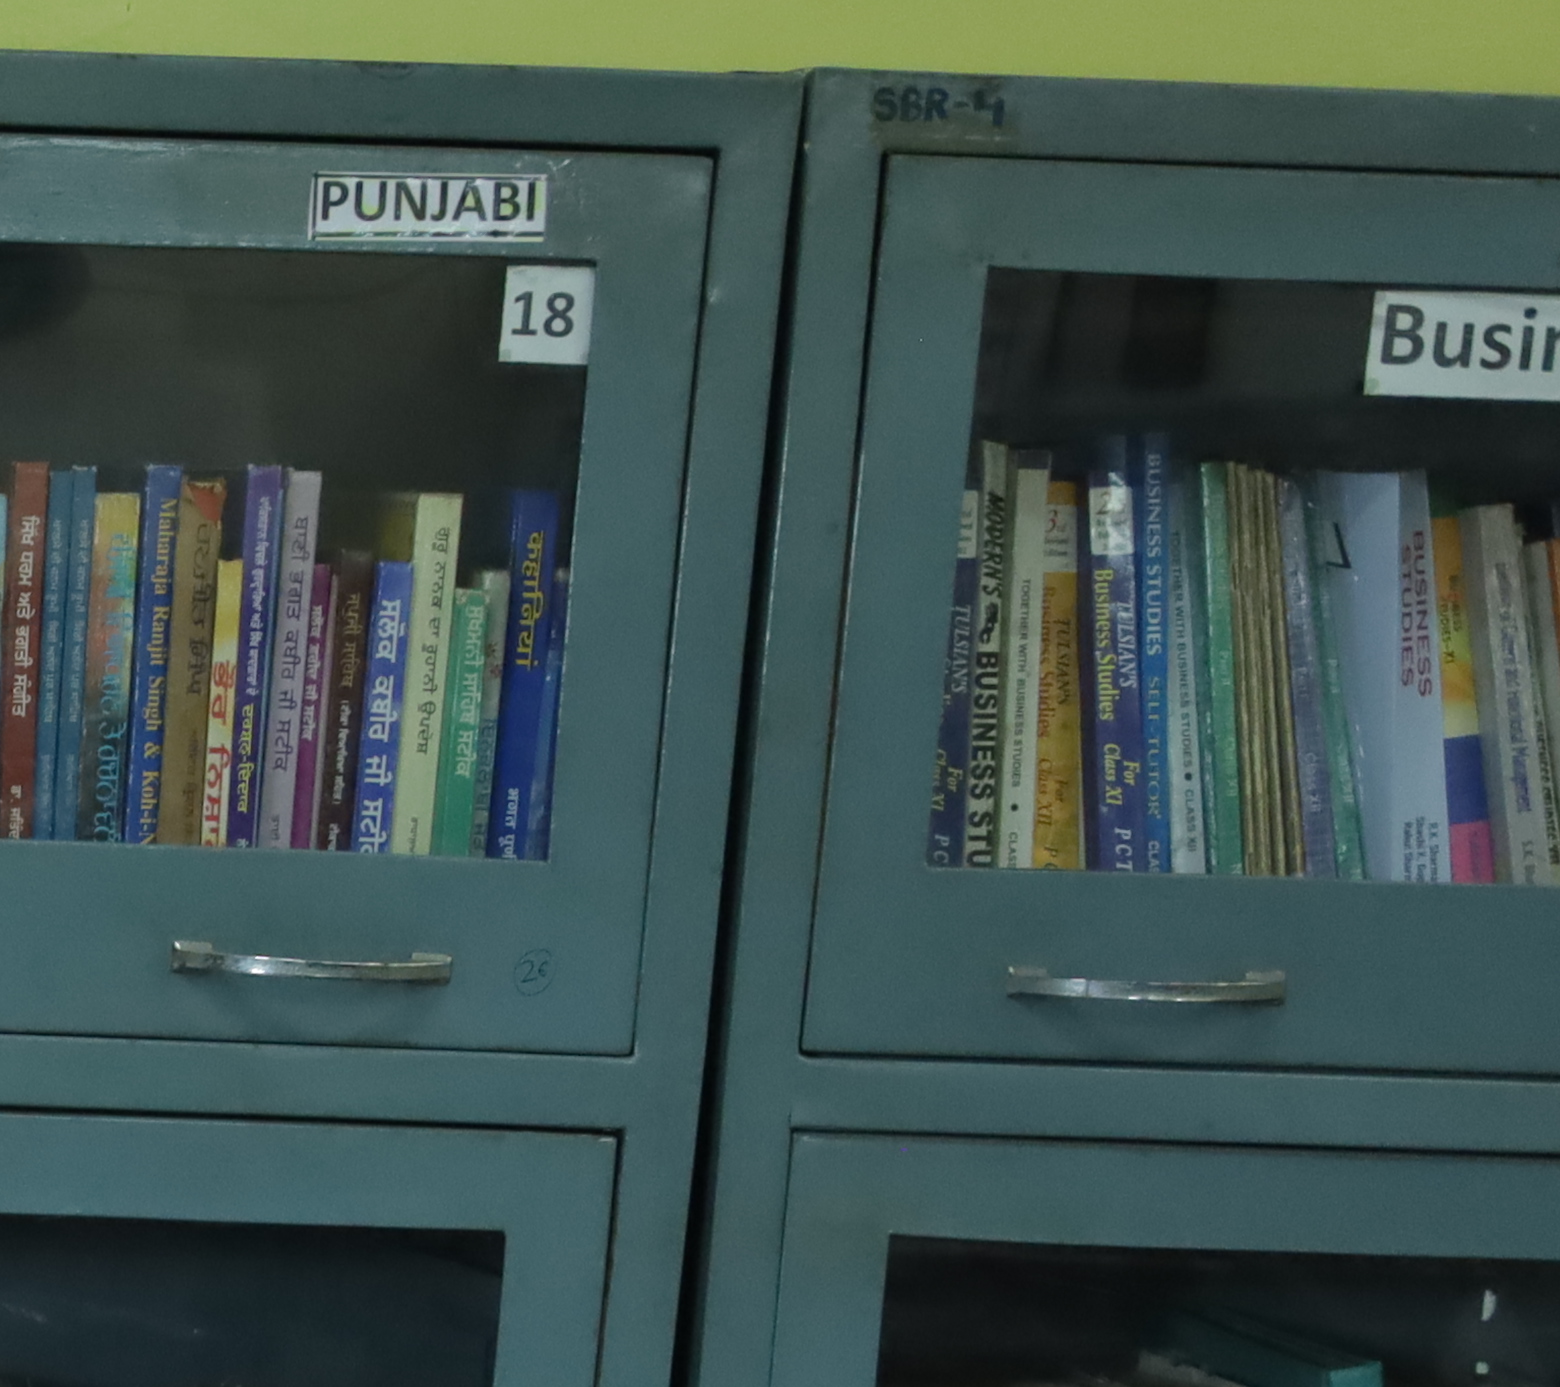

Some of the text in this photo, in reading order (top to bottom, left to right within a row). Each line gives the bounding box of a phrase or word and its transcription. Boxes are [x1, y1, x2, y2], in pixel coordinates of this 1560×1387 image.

[321, 180, 537, 222] PUNJABI
[511, 291, 576, 337] 18
[1146, 454, 1162, 557] BUSINESS
[290, 517, 311, 560] ਬਾਣੀ
[981, 492, 1003, 598] MODERN'S
[17, 551, 33, 584] ਧਰਮ
[430, 561, 449, 610] ਨਾਨਕ
[144, 499, 176, 759] Maharaja Ranjit Singh &
[429, 617, 441, 638] ਦਾ
[1146, 564, 1163, 656] STUDIES
[1400, 543, 1414, 686] STUDIES
[1412, 531, 1433, 696] BUSINESS
[13, 625, 31, 667] ਭਗਤੀ
[281, 629, 302, 680] ਕਬੀਰ
[951, 605, 971, 693] TULSIAN'S
[1093, 569, 1119, 721] Business Studies
[1116, 601, 1136, 689] TULSIAN'S
[277, 690, 297, 710] ਜੀ
[368, 675, 400, 742] ਕਬੀਰ
[272, 720, 293, 772] ਸਟੀਕ
[364, 755, 391, 787] ਜੀ
